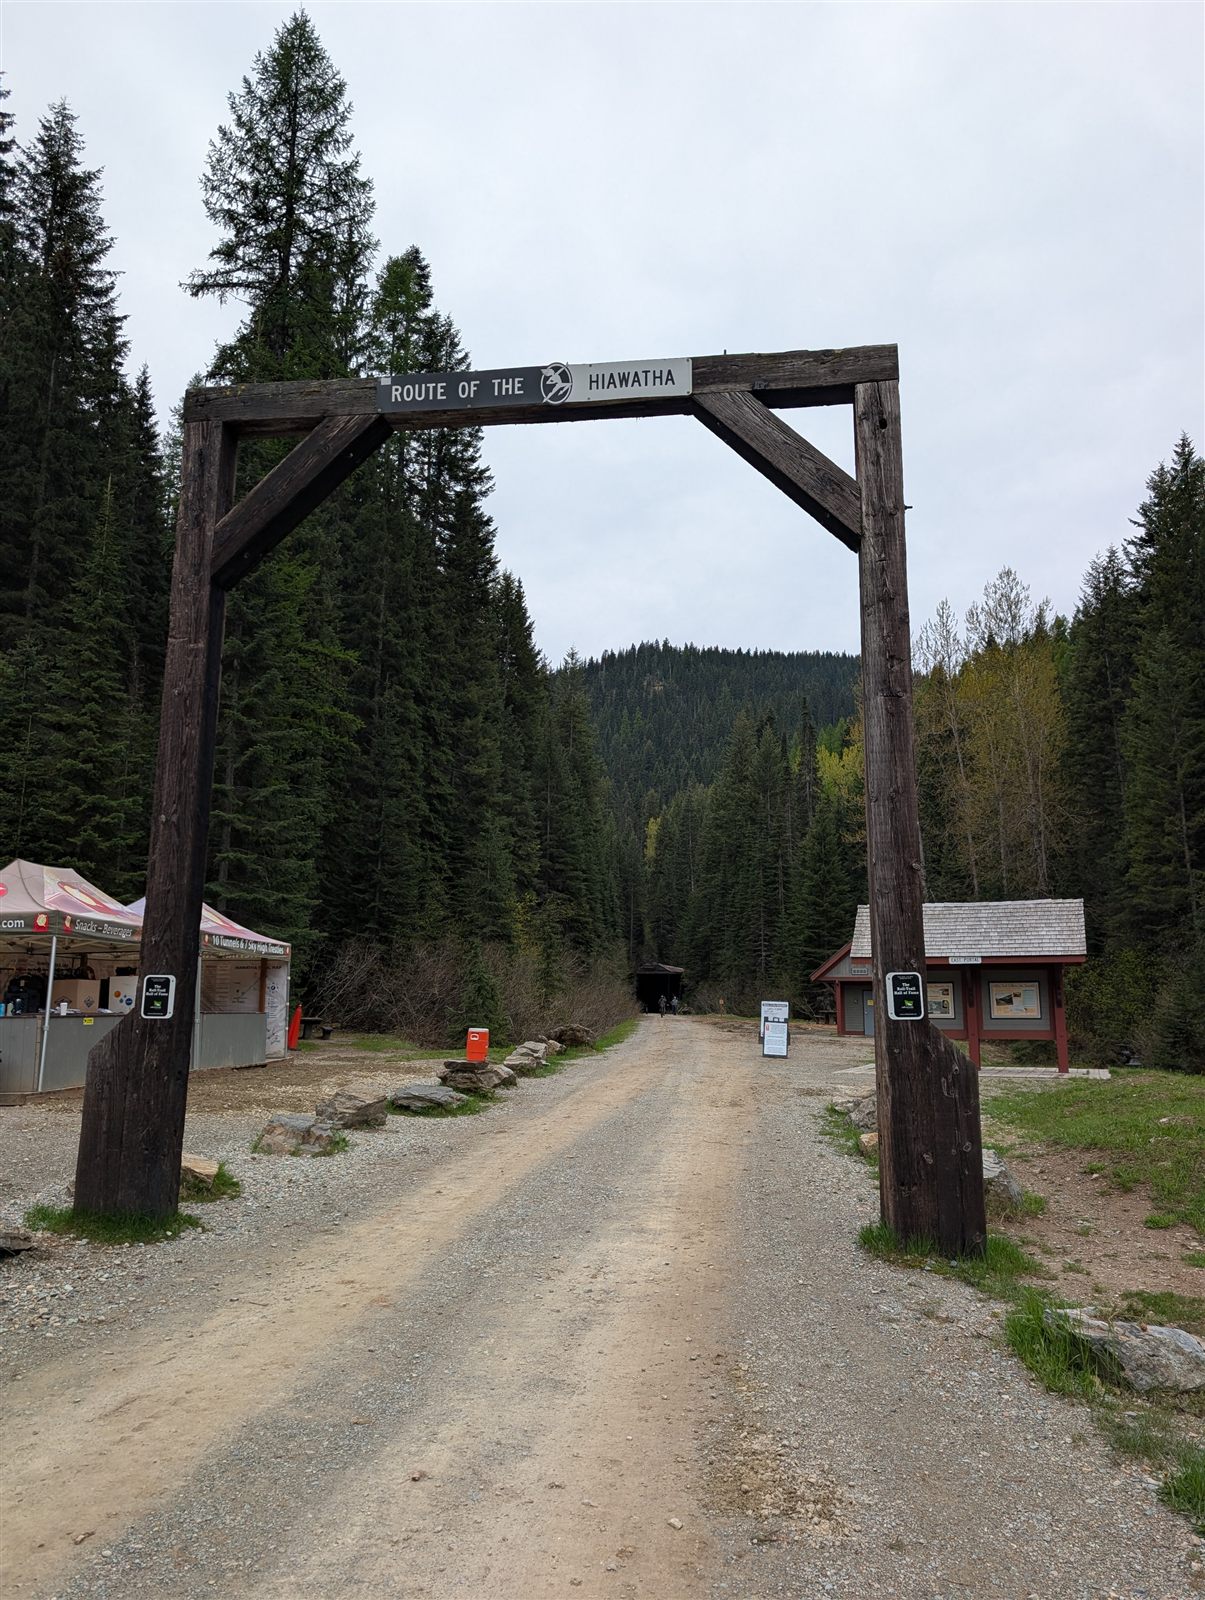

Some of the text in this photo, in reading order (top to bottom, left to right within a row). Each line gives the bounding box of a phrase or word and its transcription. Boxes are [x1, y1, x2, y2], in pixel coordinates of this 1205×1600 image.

[391, 377, 525, 402] ROUTE OF THE
[588, 369, 676, 391] HIAWATHA
[75, 919, 97, 932] Snacks
[102, 924, 133, 938] Beverages
[212, 935, 219, 945] 10
[220, 936, 240, 948] Tunnels
[240, 941, 245, 949] &
[248, 941, 257, 952] Sky
